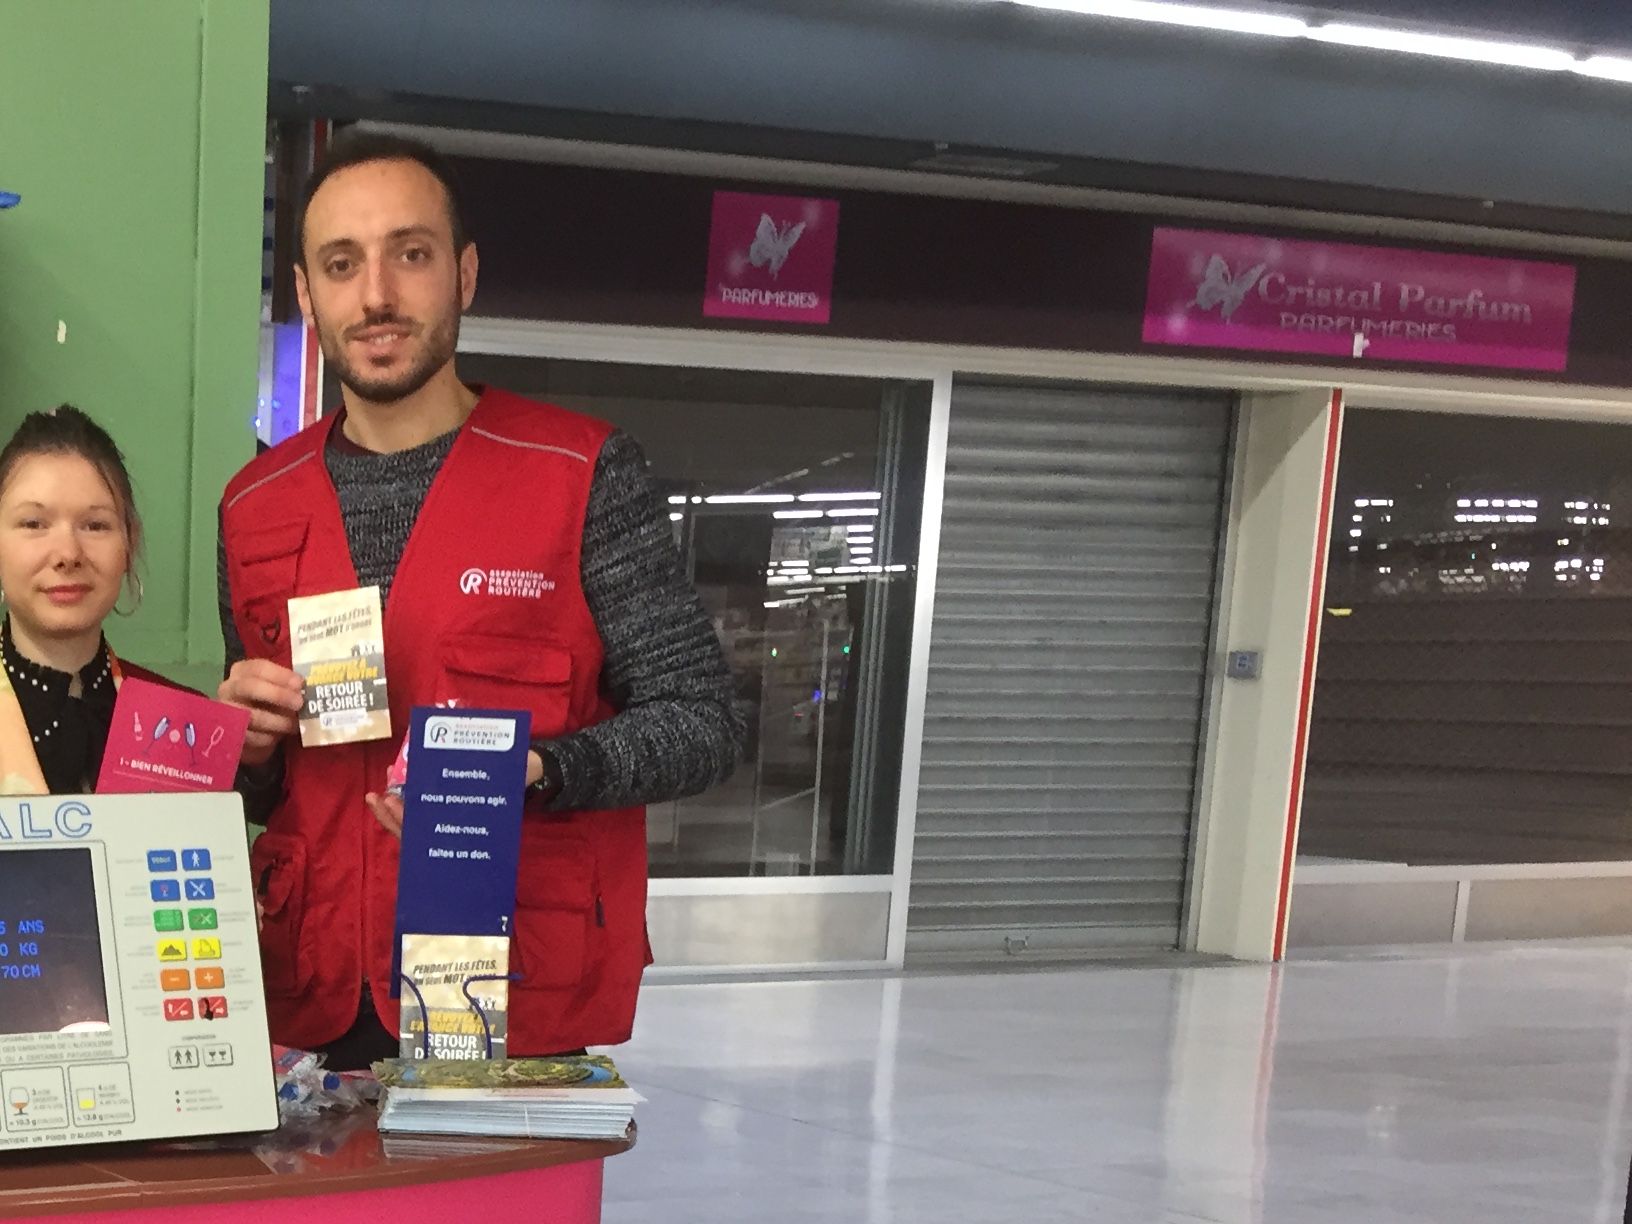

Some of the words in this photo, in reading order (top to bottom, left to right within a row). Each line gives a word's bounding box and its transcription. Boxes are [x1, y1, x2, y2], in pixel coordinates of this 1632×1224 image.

[722, 287, 819, 309] PARFUMERIES
[1258, 272, 1382, 311] Cristal
[1399, 282, 1532, 324] Parfum
[1279, 312, 1457, 341] PARFUMERIES
[489, 569, 544, 580] association
[488, 577, 555, 591] PRÉVENTION
[297, 617, 332, 632] PENDANT
[325, 625, 343, 637] MOT
[315, 681, 363, 699] RETOUR
[308, 700, 324, 714] DE
[326, 694, 368, 711] SOIRÉE
[453, 729, 510, 740] PRÉVENTION
[453, 737, 497, 746] ROUTIÈRE
[130, 759, 151, 773] BIEN
[152, 761, 213, 785] RÉVEILLONNER
[421, 793, 444, 803] nous
[445, 795, 485, 805] pouvons
[429, 848, 454, 858] faites
[456, 850, 468, 858] un
[18, 919, 45, 934] ANS
[19, 942, 38, 956] KG
[413, 961, 453, 975] PENDANT
[454, 961, 470, 972] LES
[443, 972, 465, 984] MOT
[414, 1047, 431, 1060] D
[108, 1129, 122, 1137] PUR
